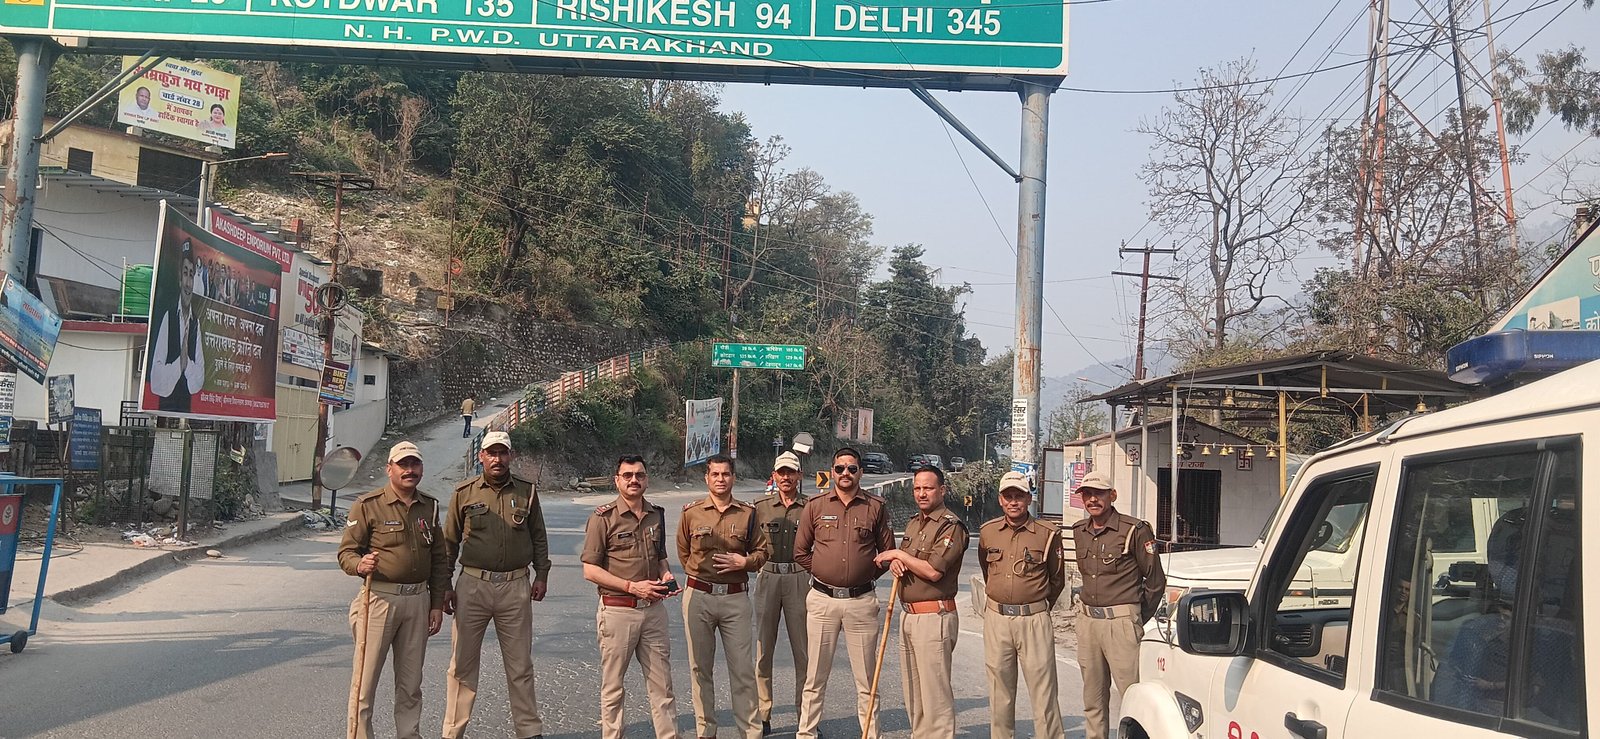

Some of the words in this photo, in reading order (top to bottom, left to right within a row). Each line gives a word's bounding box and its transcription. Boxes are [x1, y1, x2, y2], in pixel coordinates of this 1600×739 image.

[270, 0, 438, 14] DWAR
[556, 0, 736, 28] RISHIKESH
[755, 3, 792, 30] 94
[834, 5, 933, 33] DELHI
[946, 8, 1001, 36] 345
[431, 27, 520, 45] P.W.D.
[538, 32, 773, 57] UTTARAKHAND
[215, 216, 247, 242] AKASHDEEP
[246, 232, 271, 256] EMPORIUM
[332, 369, 347, 378] BIKE
[1157, 657, 1166, 672] 112
